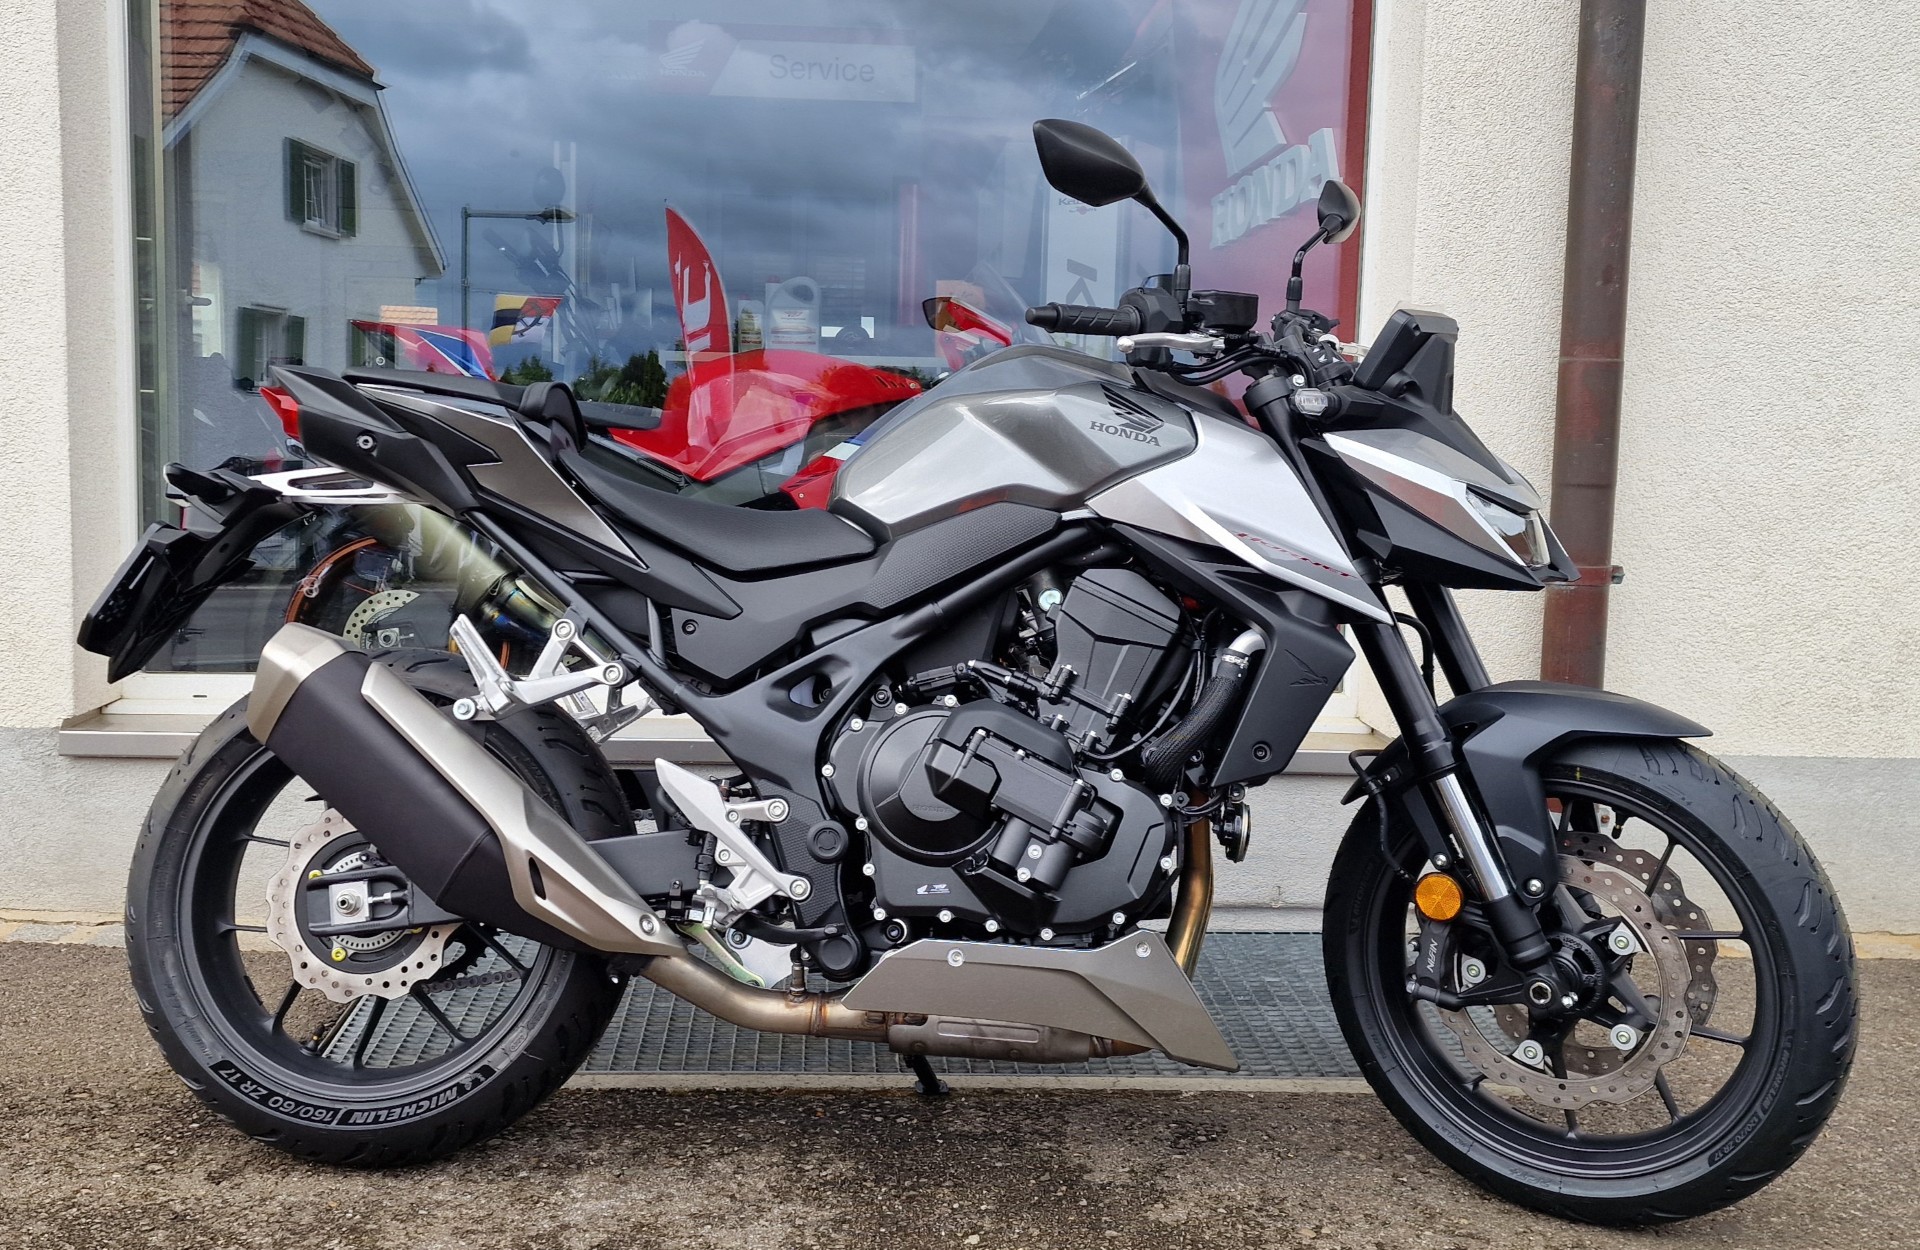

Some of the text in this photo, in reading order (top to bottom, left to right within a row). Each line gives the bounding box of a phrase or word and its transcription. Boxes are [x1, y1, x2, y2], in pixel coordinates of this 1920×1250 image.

[769, 54, 875, 82] Service
[1210, 127, 1342, 249] HONDA
[1088, 420, 1162, 448] HONDA
[218, 1067, 458, 1126] MICHELIN 160/60 ZR 17
[1762, 1049, 1791, 1110] MICHELIN
